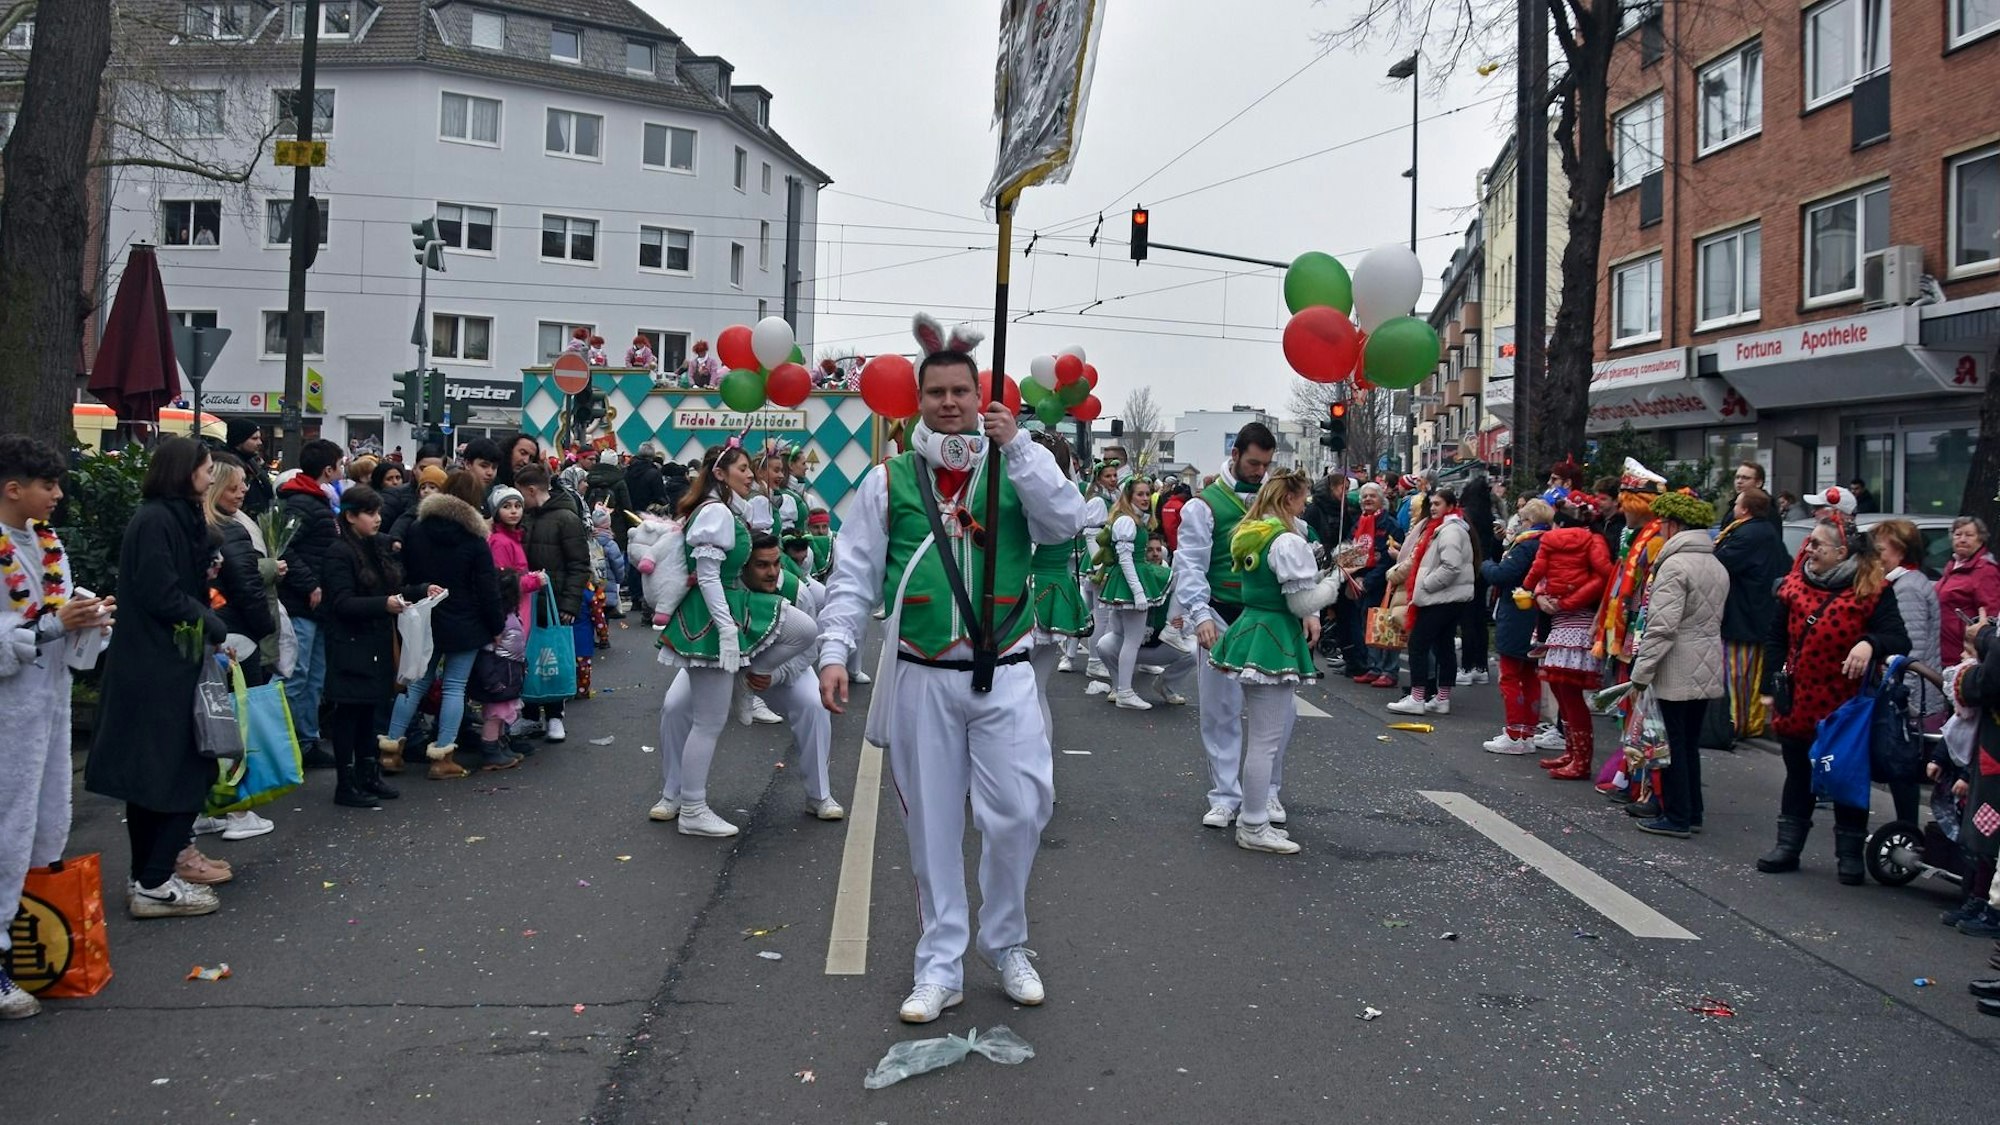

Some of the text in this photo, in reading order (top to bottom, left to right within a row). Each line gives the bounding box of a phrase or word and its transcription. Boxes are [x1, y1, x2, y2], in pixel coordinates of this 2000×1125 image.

[1737, 323, 1868, 360] Fortuna Apotheke
[1608, 366, 1639, 382] pharmacy
[1640, 358, 1681, 376] consultancy
[445, 383, 517, 400] tipster
[1632, 393, 1707, 418] Apotheke
[679, 413, 798, 427] Fidele Zunftbrüder
